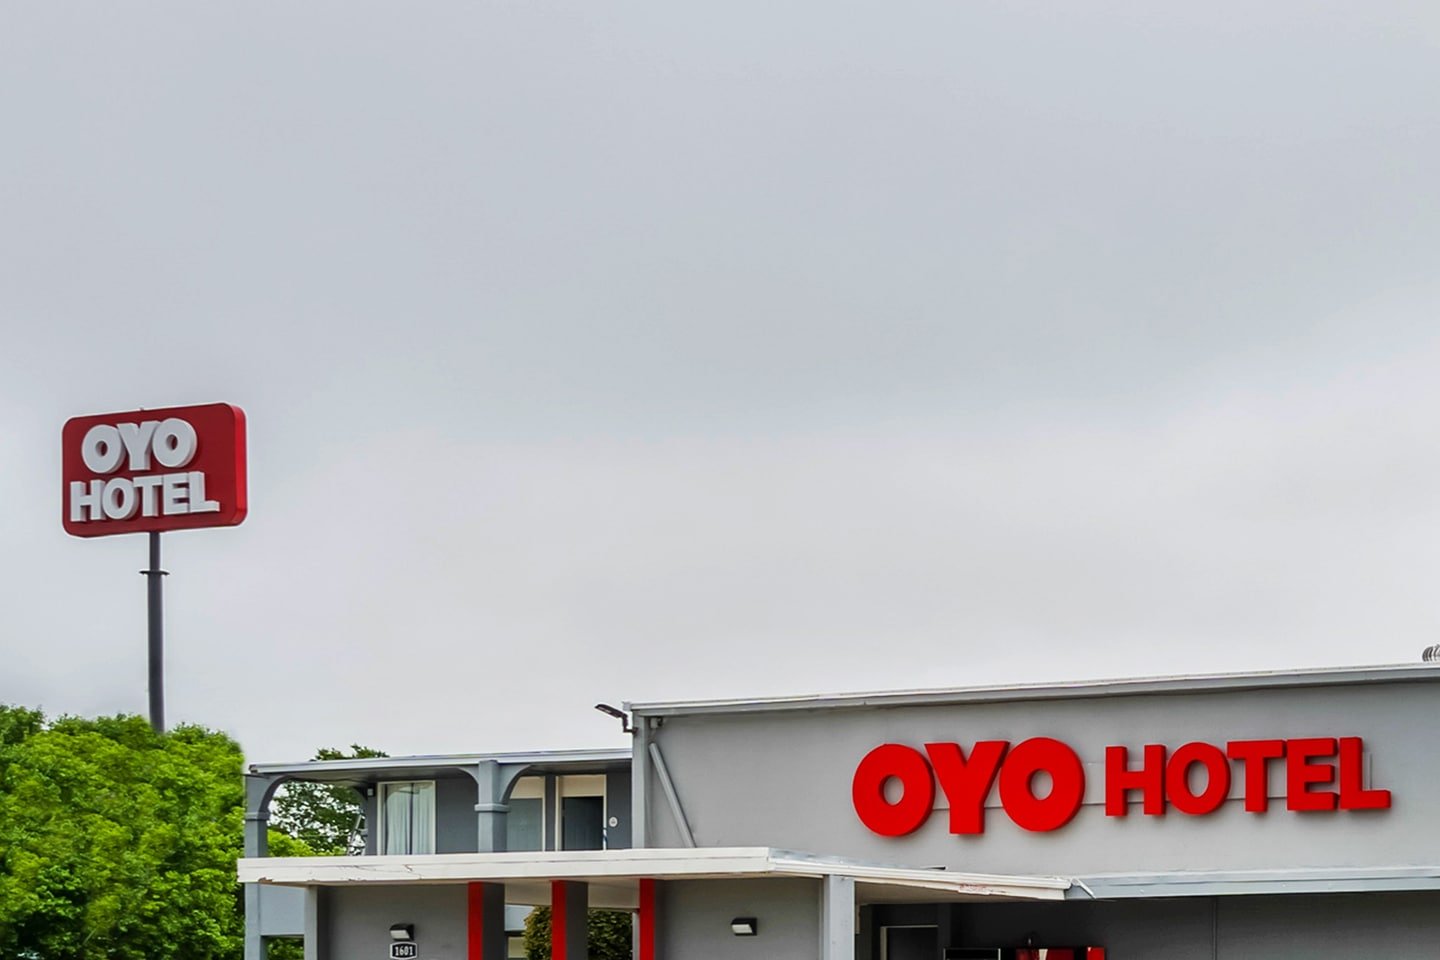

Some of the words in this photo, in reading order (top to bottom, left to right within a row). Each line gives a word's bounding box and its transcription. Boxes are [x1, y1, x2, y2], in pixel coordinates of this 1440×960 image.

[81, 417, 198, 474] OYO
[70, 470, 220, 522] HOTEL
[852, 737, 1085, 836] OYO
[1105, 737, 1391, 816] HOTEL
[394, 945, 414, 956] 1601
